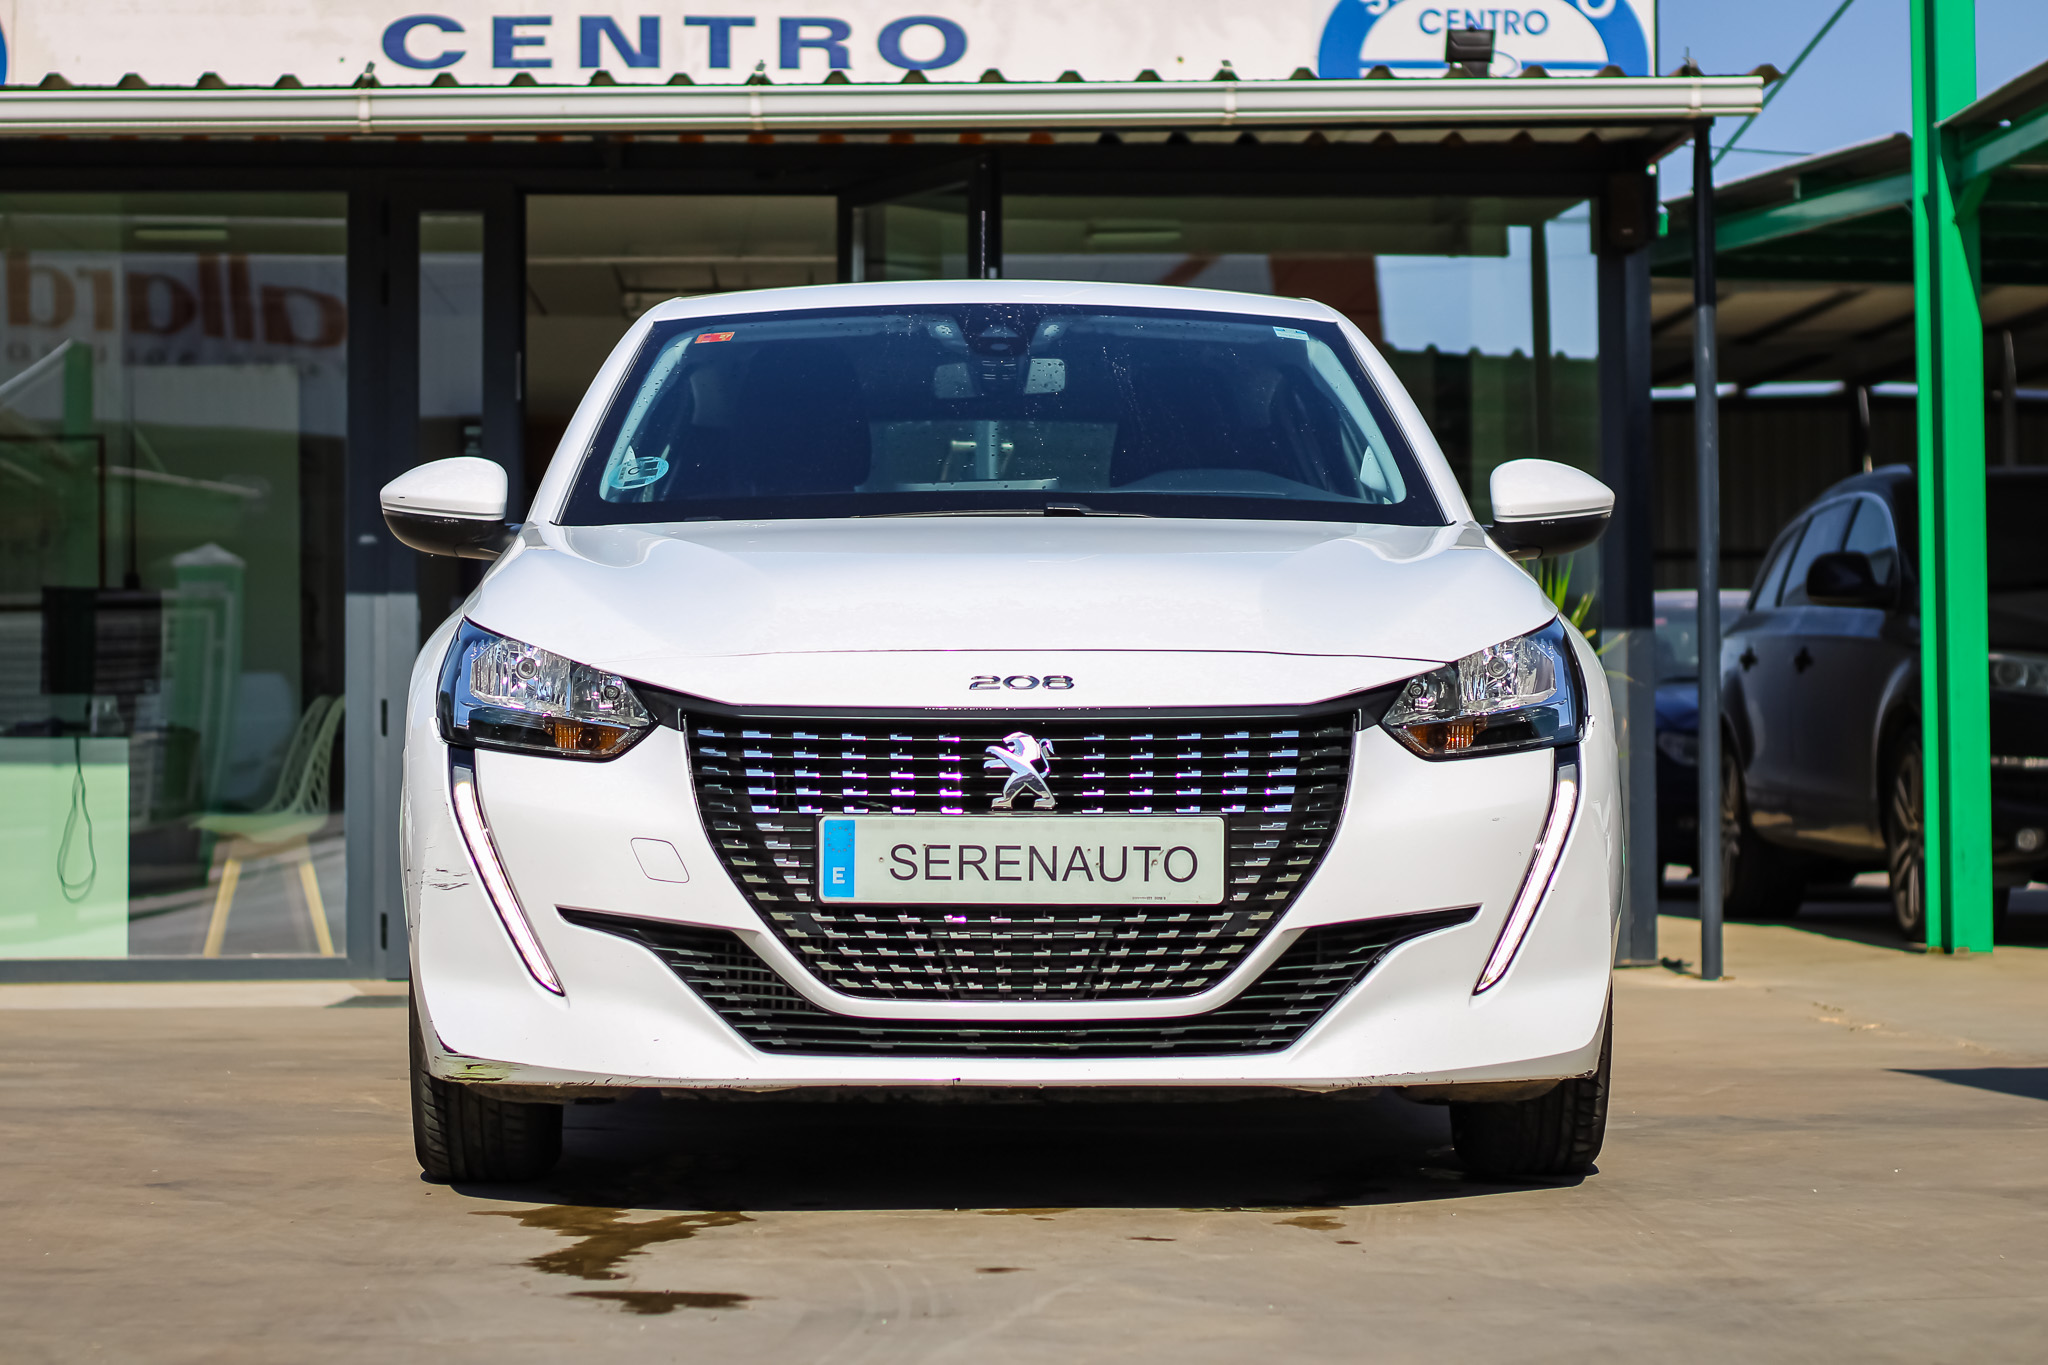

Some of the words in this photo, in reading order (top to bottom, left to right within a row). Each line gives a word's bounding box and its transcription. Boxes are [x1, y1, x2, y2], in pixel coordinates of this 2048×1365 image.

[1418, 9, 1549, 35] CENTRO
[381, 14, 968, 70] CENTRO
[968, 674, 1075, 690] 208
[832, 866, 846, 884] E
[889, 843, 1198, 882] SERENAUTO
